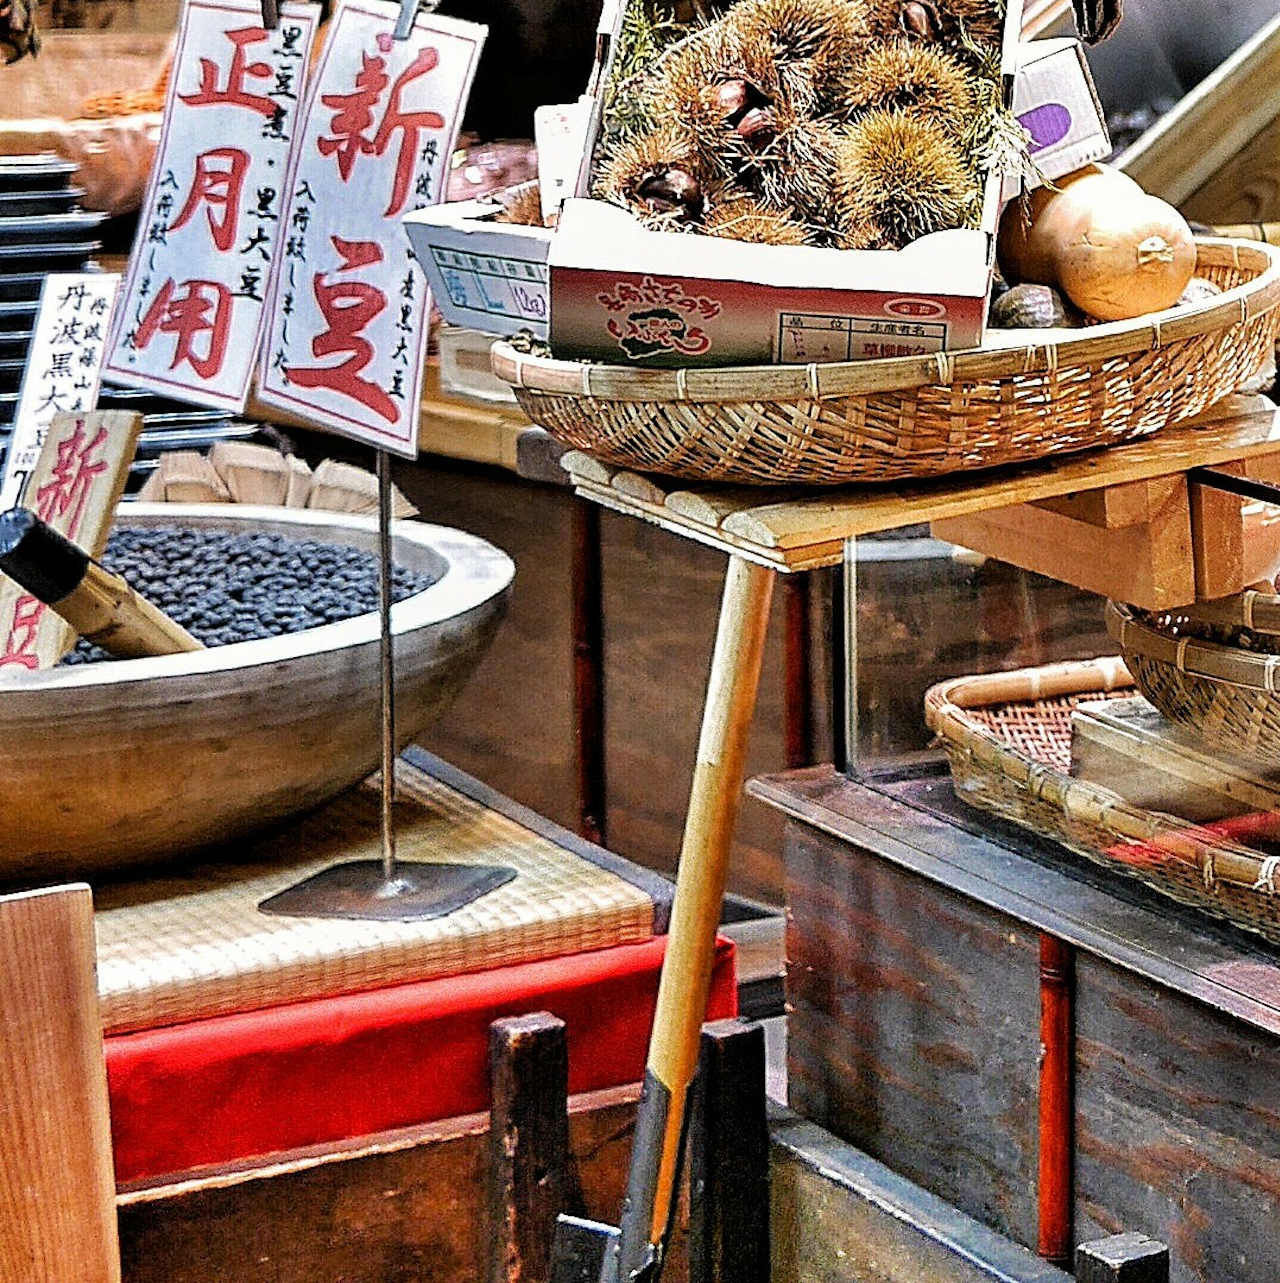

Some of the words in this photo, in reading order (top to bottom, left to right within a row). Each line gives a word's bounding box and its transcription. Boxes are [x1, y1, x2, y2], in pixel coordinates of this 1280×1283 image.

[135, 26, 280, 381] 正月用
[284, 33, 447, 425] 新豆
